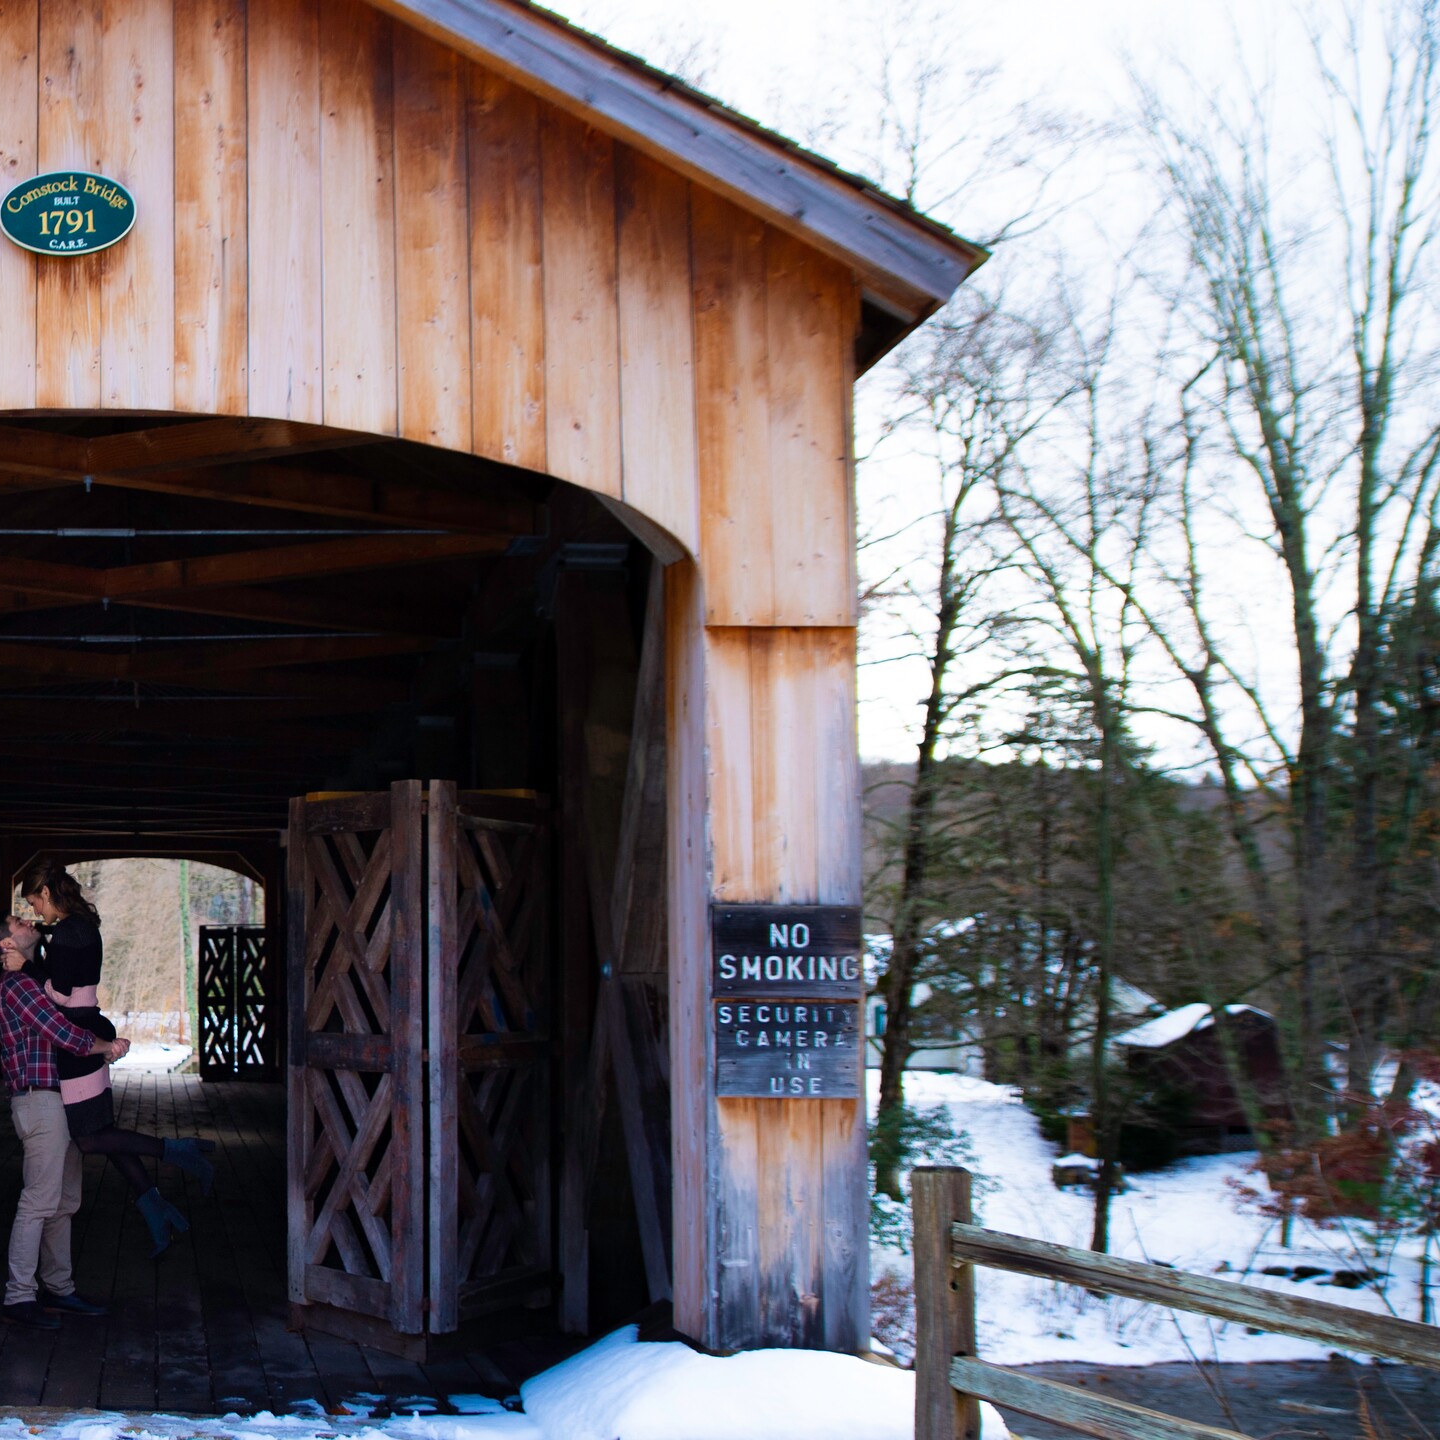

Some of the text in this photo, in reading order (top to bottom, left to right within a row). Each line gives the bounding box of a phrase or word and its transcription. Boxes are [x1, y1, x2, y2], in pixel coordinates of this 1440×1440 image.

[6, 175, 128, 213] Comstock Bridge
[53, 196, 80, 206] BUILT
[38, 209, 96, 235] 1791
[769, 923, 810, 948] NO
[719, 954, 859, 981] SMOKING
[719, 1005, 852, 1024] SECURITY
[735, 1030, 847, 1048] CAMERA
[770, 1077, 823, 1094] USE
